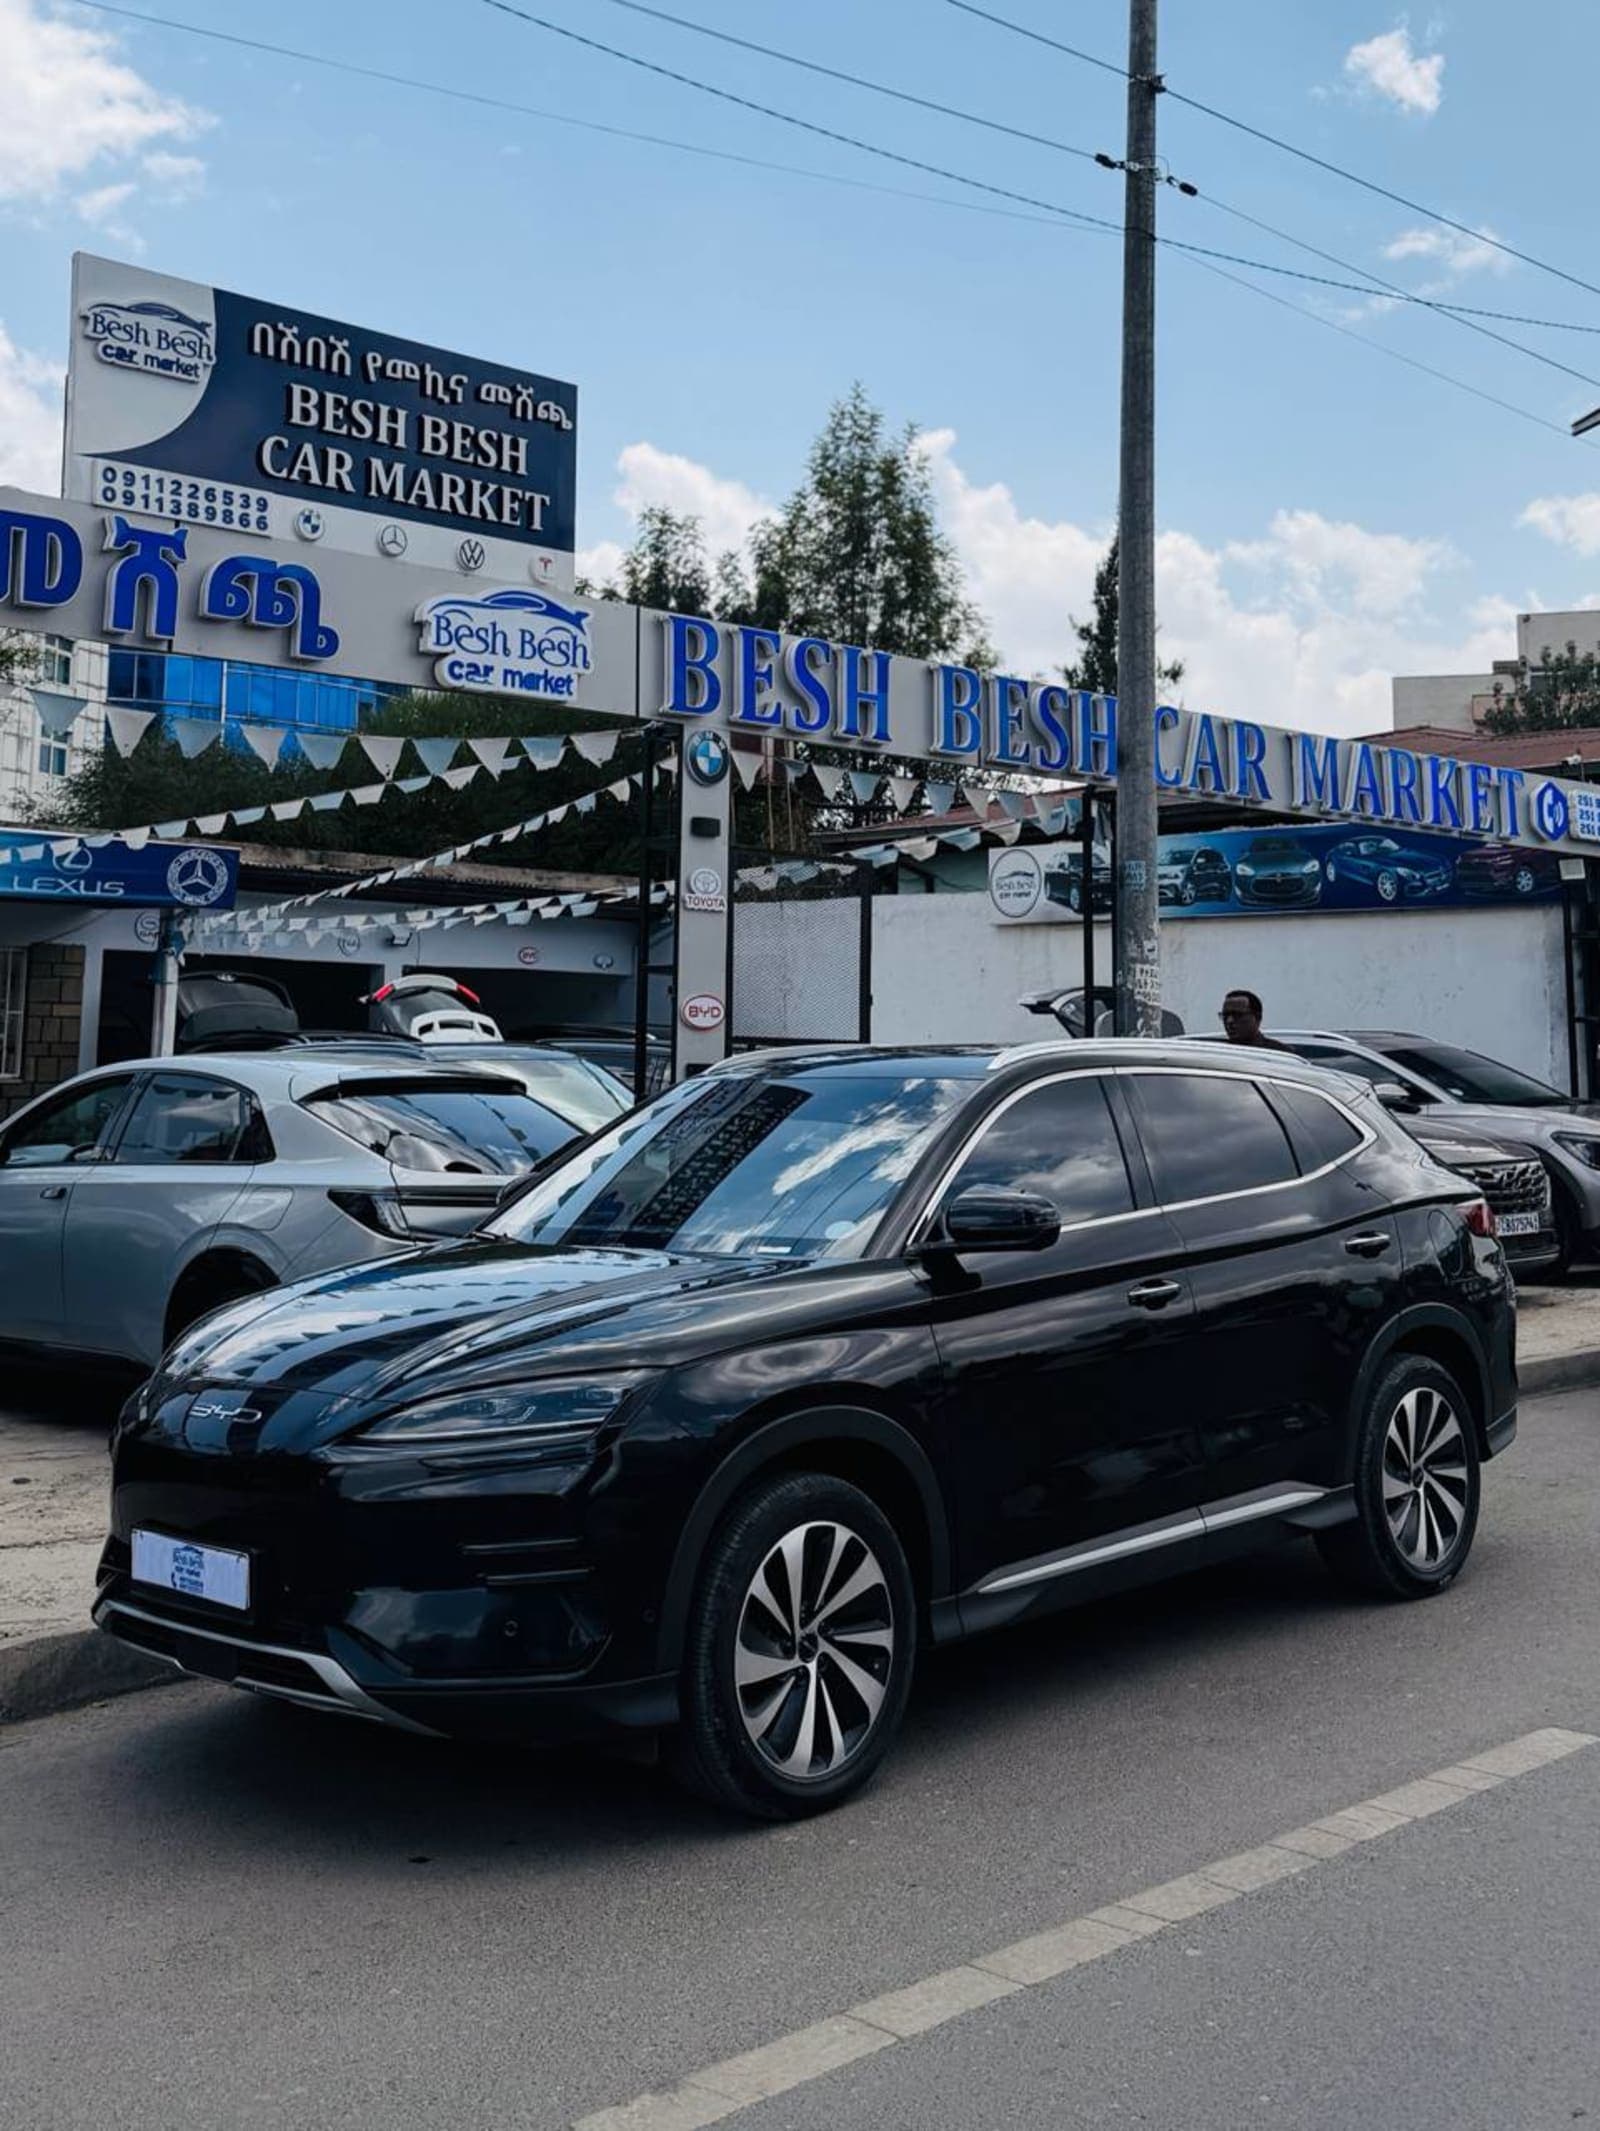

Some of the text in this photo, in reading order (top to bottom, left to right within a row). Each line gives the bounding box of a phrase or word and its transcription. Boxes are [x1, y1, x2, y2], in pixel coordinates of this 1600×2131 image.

[92, 312, 213, 363] Besh Besh
[101, 344, 200, 378] car market
[289, 382, 529, 476] BESH BESH
[101, 466, 270, 513] 0911226539
[261, 434, 551, 532] CAR MARKET
[101, 486, 270, 532] 0911389866
[433, 612, 591, 670] Besh Besh
[448, 660, 574, 696] car market
[662, 614, 1525, 839] BESH BESH CAR MARKET
[13, 875, 125, 897] LEXUS
[686, 893, 727, 910] TOYOTA
[689, 1005, 721, 1018] BYD
[190, 1404, 262, 1423] BYD
